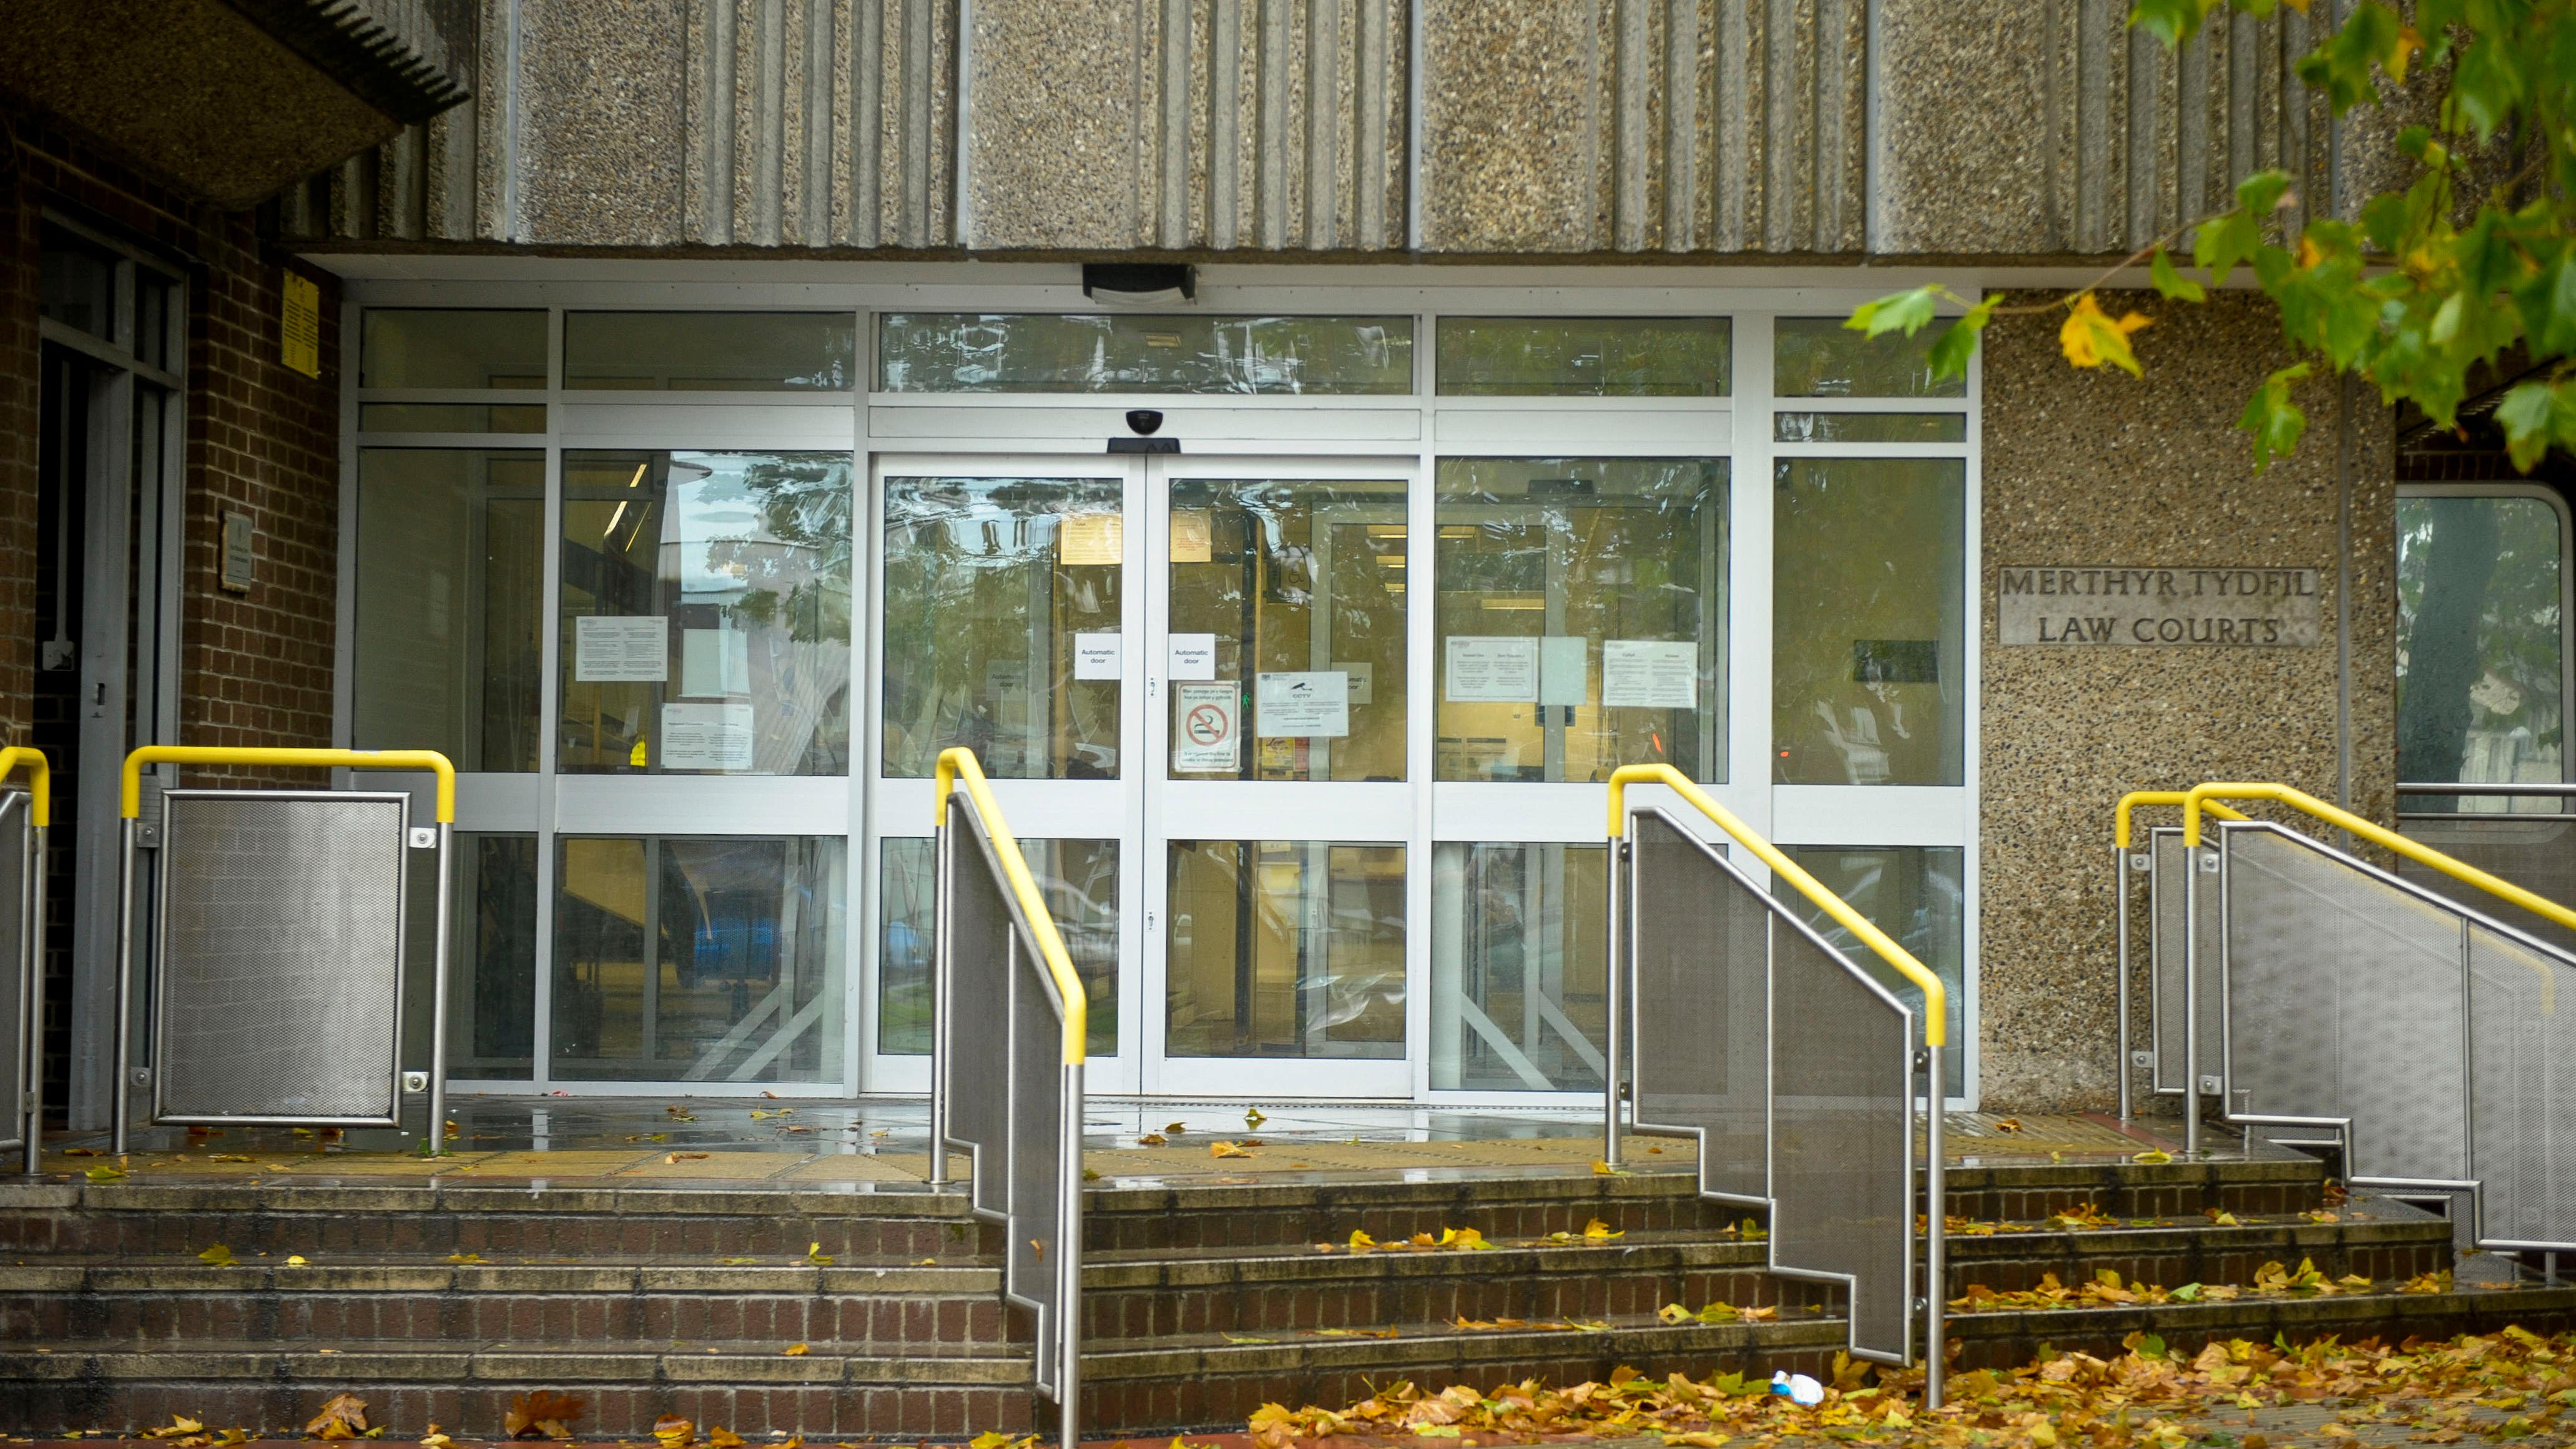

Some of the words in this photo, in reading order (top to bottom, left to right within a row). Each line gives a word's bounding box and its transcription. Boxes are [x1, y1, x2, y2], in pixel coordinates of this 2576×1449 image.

[2002, 569, 2178, 596] MERTHYR
[2188, 571, 2313, 596] TYDFIL
[2038, 617, 2118, 643] LAW
[2132, 617, 2279, 644] COURTS
